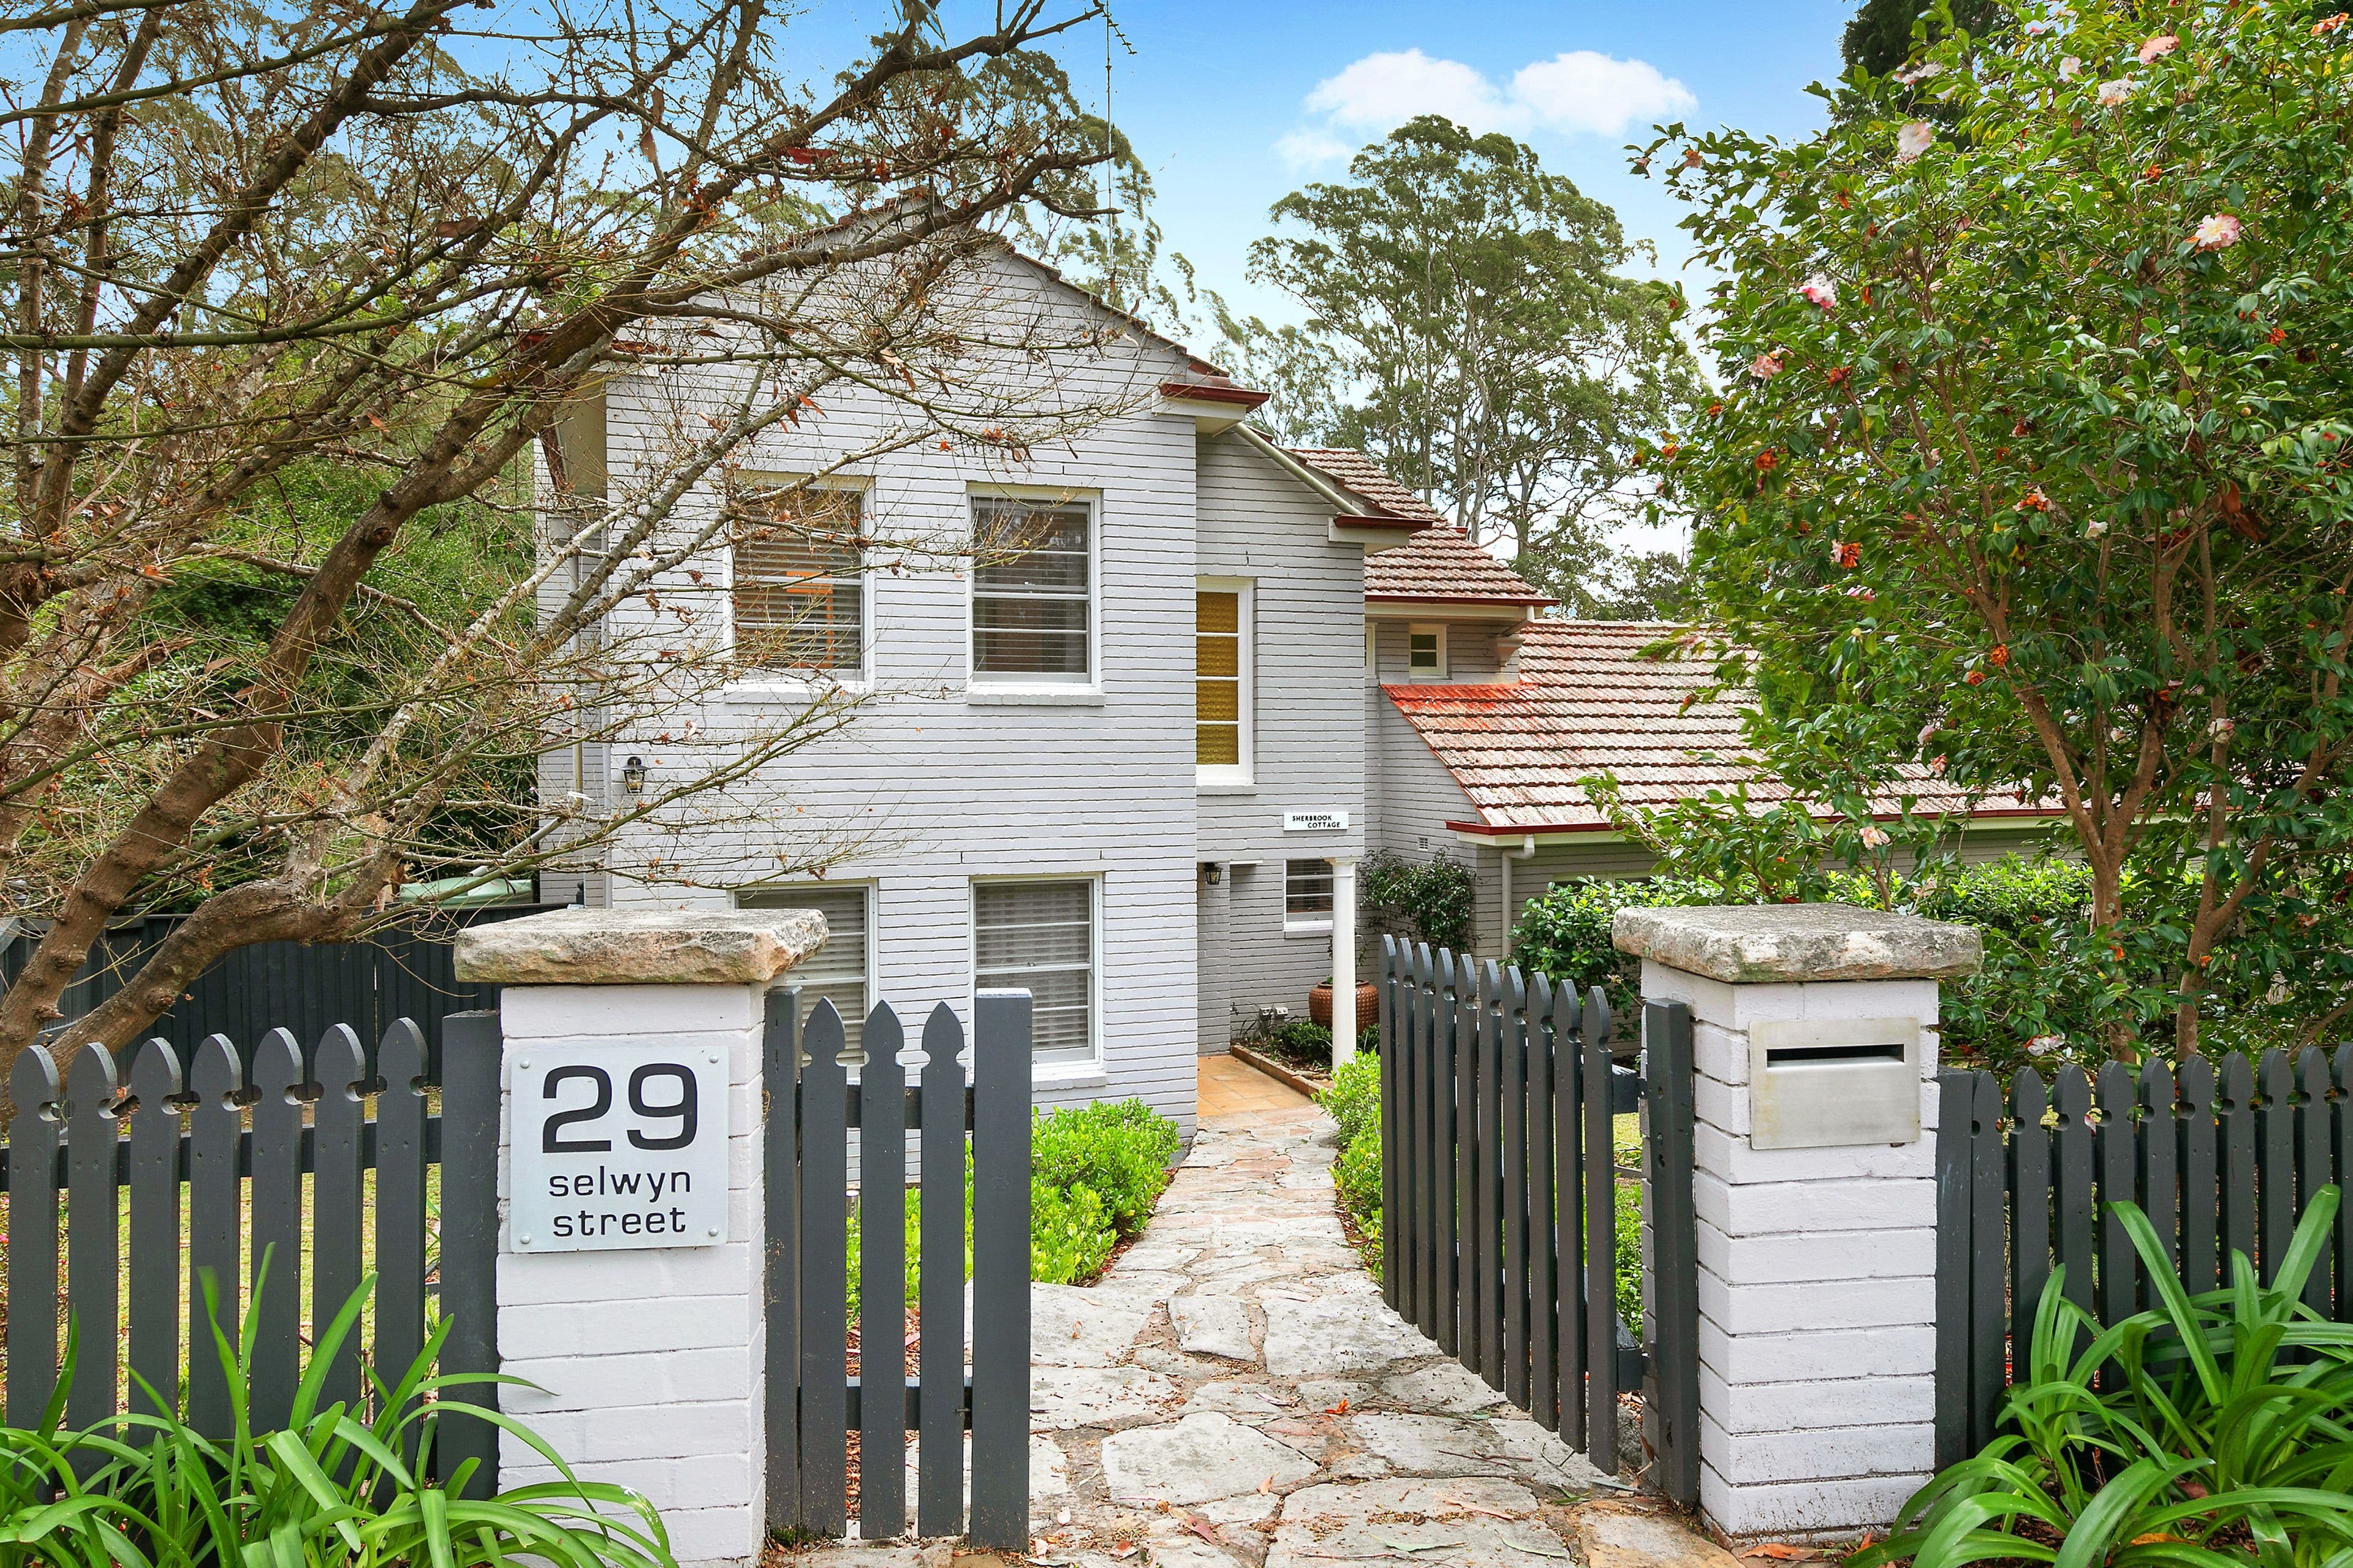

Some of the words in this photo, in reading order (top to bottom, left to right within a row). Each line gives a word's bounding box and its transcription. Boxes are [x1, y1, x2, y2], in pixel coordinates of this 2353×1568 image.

[542, 1062, 698, 1153] 29
[548, 1165, 691, 1203] selwyn
[553, 1206, 686, 1237] street
